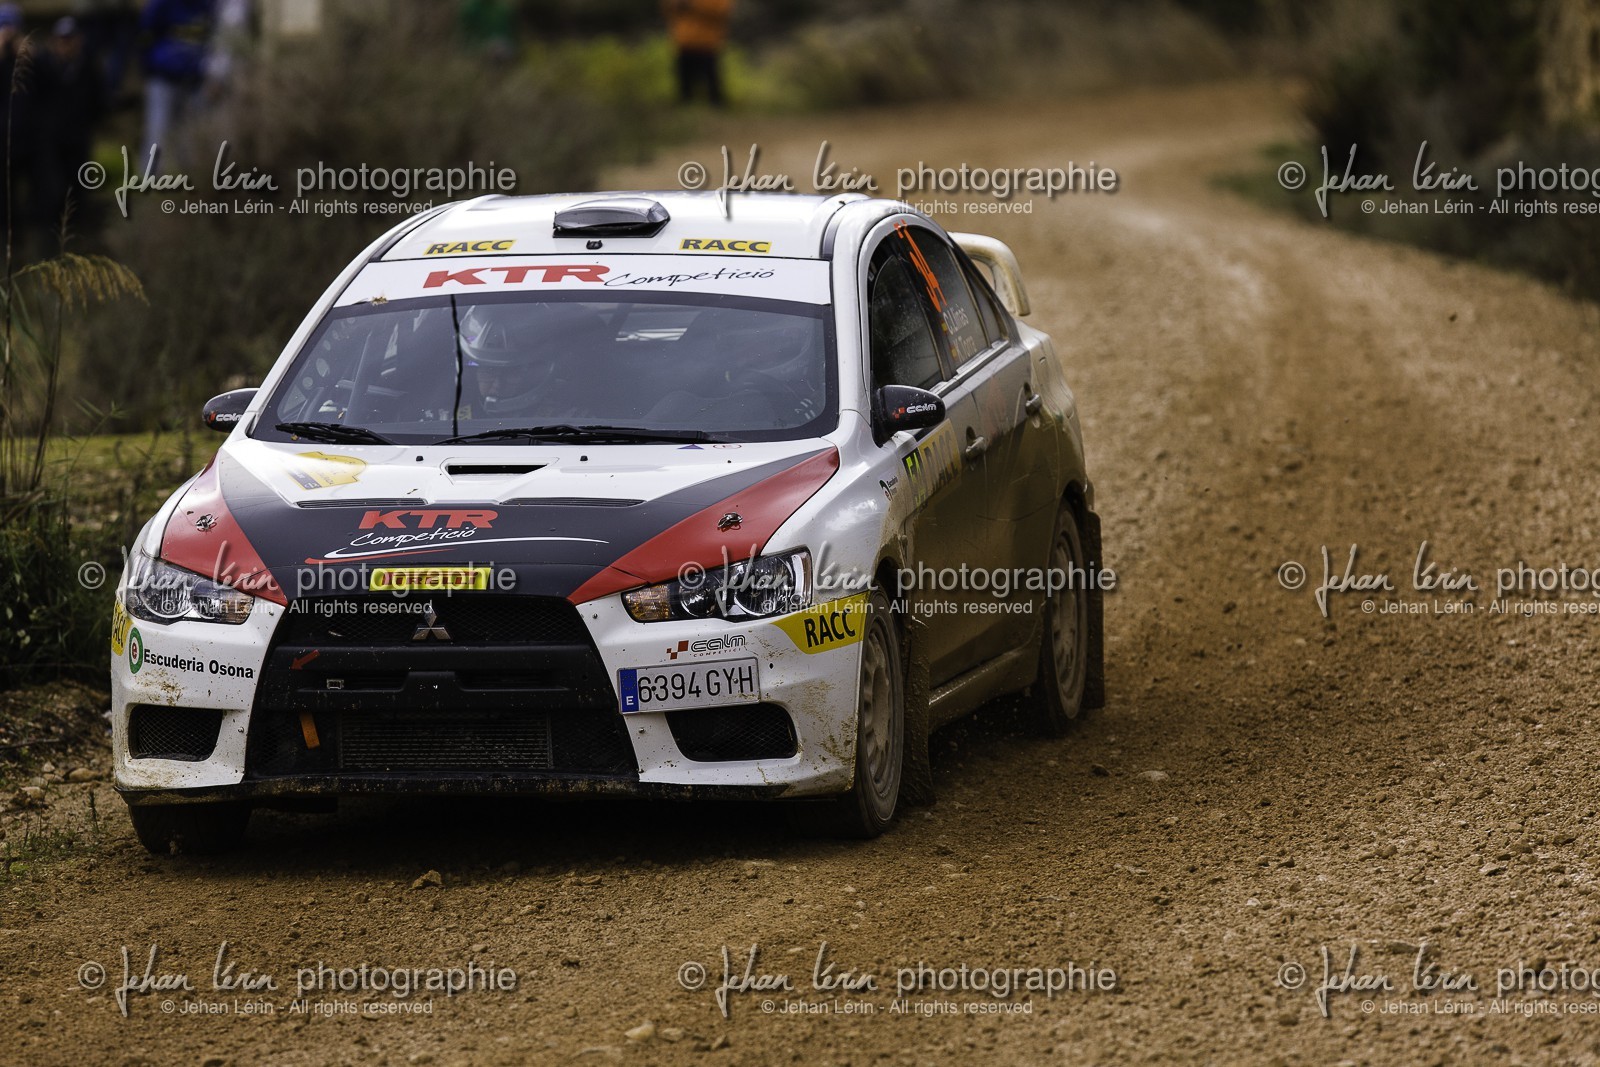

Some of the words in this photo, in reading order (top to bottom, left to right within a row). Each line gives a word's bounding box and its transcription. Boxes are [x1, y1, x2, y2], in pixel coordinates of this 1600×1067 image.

[427, 240, 513, 254] RACC
[682, 239, 768, 252] RACC
[423, 265, 610, 288] KTR
[604, 267, 775, 287] Competició
[358, 509, 498, 529] KTR
[350, 527, 478, 547] Competició
[804, 608, 856, 648] RACC
[690, 634, 746, 652] calm
[143, 648, 204, 672] Escuderia
[209, 659, 254, 679] Osona
[638, 671, 702, 702] 6394
[706, 666, 753, 696] GYH
[625, 695, 634, 705] E
